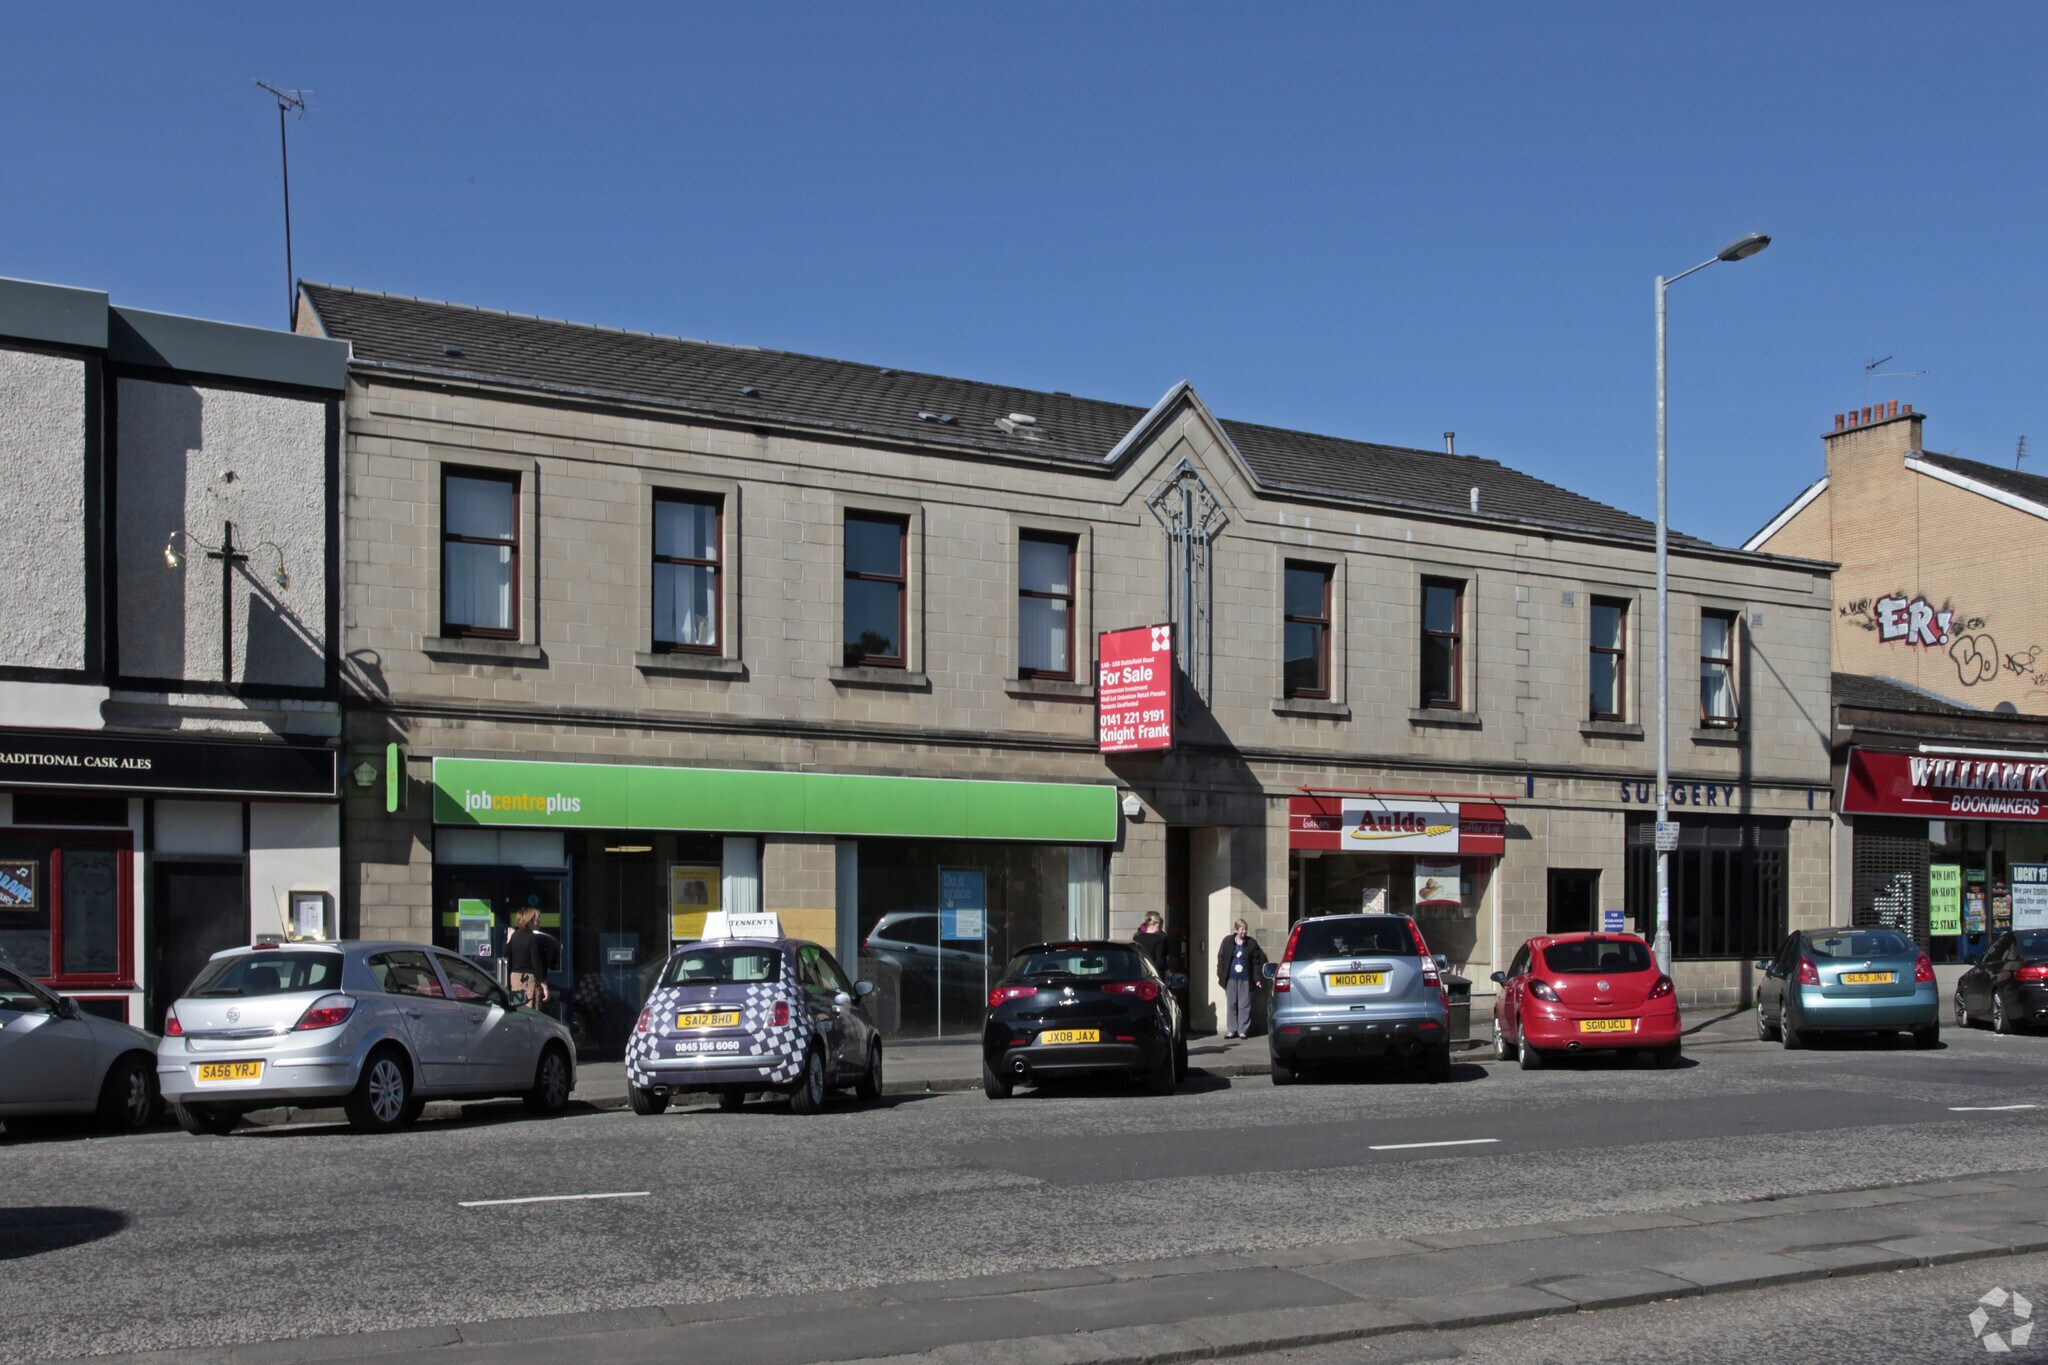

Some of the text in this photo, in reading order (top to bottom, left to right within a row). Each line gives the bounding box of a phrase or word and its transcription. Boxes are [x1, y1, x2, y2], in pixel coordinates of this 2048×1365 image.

[1100, 665, 1153, 686] For Sale
[1101, 709, 1165, 726] 0141 221 9191
[1100, 723, 1169, 744] Knight Frank
[84, 757, 118, 768] CASK
[120, 758, 152, 769] ALES
[1909, 756, 2029, 791] WILLIAM
[1621, 780, 1735, 807] SUGERY
[465, 789, 581, 815] jobcentreplus
[1951, 795, 2039, 815] BOOKMAKERS
[1303, 817, 1330, 829] bakers
[1359, 810, 1426, 832] Aulds
[1460, 823, 1500, 834] coffee shop
[944, 874, 956, 885] Do
[1931, 871, 1942, 880] WIN
[1944, 870, 1957, 880] LOTS
[2014, 867, 2048, 882] LUCKY 15
[944, 887, 972, 898] online
[1932, 887, 1956, 897] ON SLOTS
[2015, 896, 2026, 904] odds
[2036, 897, 2047, 905] only
[1931, 919, 1958, 930] £2 STAKE
[1847, 974, 1869, 982] SL53
[684, 1014, 732, 1026] SA12 BHD
[1586, 1020, 1626, 1030] SG10 UCU
[1047, 1031, 1095, 1043] JX08 JAX
[675, 1041, 740, 1052] 0845 166 6060
[203, 1063, 257, 1078] SA56 YRJ
